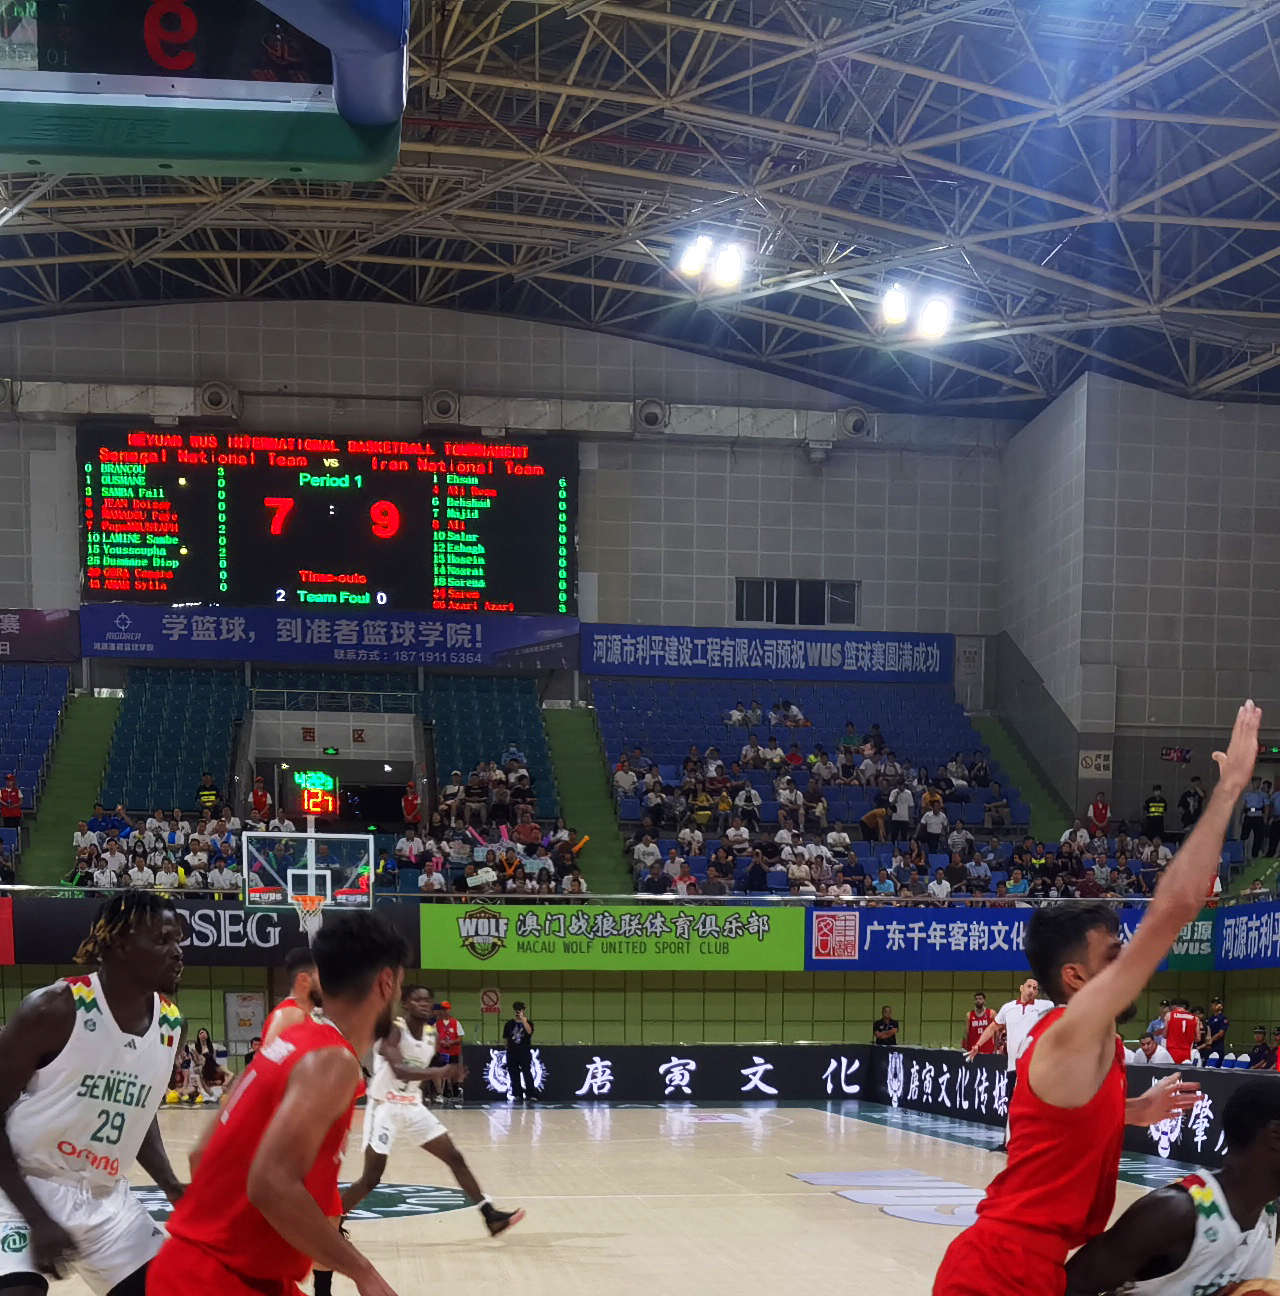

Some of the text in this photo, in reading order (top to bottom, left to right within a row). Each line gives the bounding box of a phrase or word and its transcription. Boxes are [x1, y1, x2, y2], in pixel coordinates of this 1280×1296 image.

[268, 452, 308, 467] Team
[371, 456, 408, 471] Iran
[505, 461, 545, 476] Team
[218, 478, 225, 487] 0
[299, 473, 363, 488] Period 1
[218, 490, 225, 499] 0
[218, 501, 226, 511] 0
[218, 513, 226, 522] 0
[264, 496, 294, 535] 7
[370, 500, 400, 539] 9
[87, 533, 100, 542] 10
[218, 536, 226, 546] 0
[219, 559, 227, 568] 0
[219, 570, 227, 579] 0
[219, 582, 227, 591] 0
[276, 589, 387, 605] 2 Team Foul 0
[458, 918, 508, 938] WOLF
[516, 941, 730, 955] MACAU WOLF UNITED SPORT CLUB
[1172, 941, 1212, 955] WUS
[581, 1054, 861, 1096] 唐寅文化
[90, 1109, 126, 1146] 29
